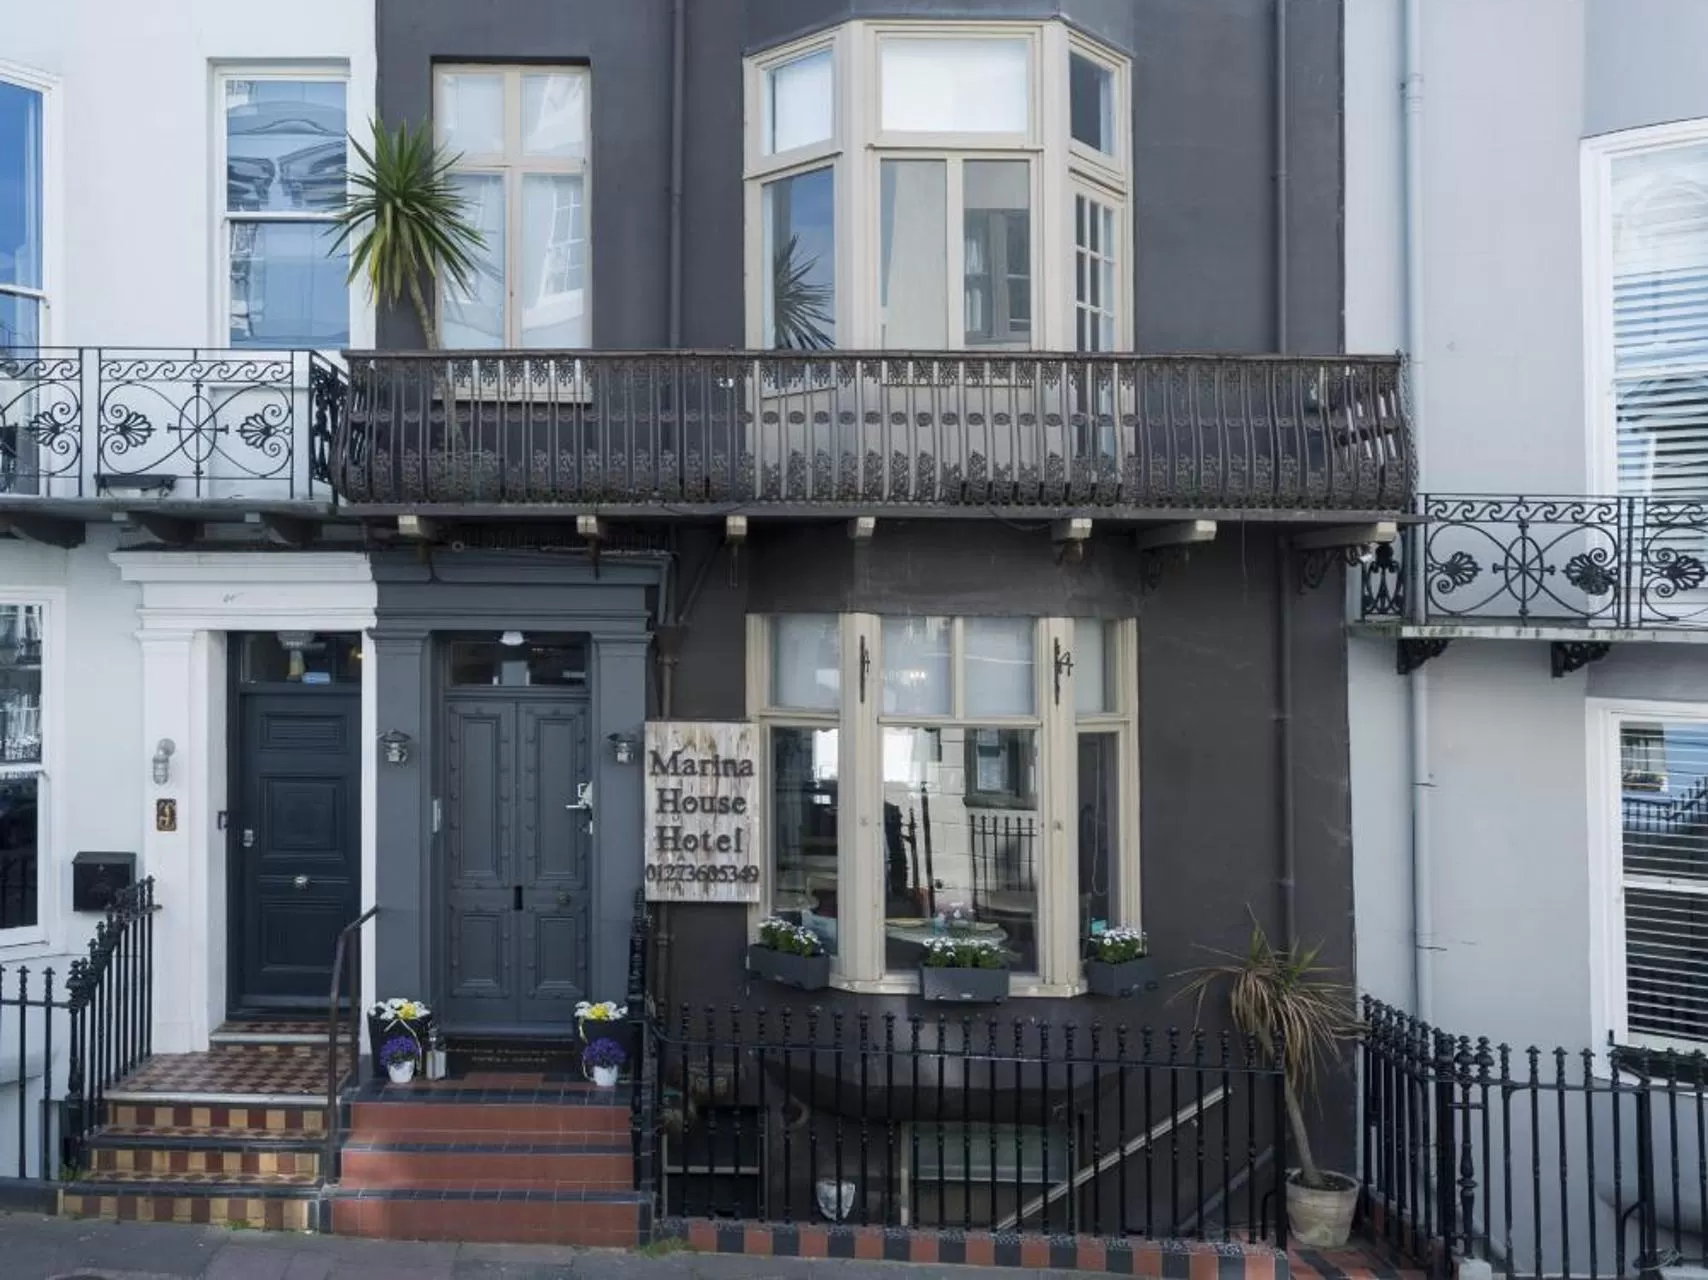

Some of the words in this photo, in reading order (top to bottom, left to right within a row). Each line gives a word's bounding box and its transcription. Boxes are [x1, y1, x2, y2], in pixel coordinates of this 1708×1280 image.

[648, 748, 755, 778] Marina
[655, 787, 748, 815] House
[655, 825, 745, 853] Hotel
